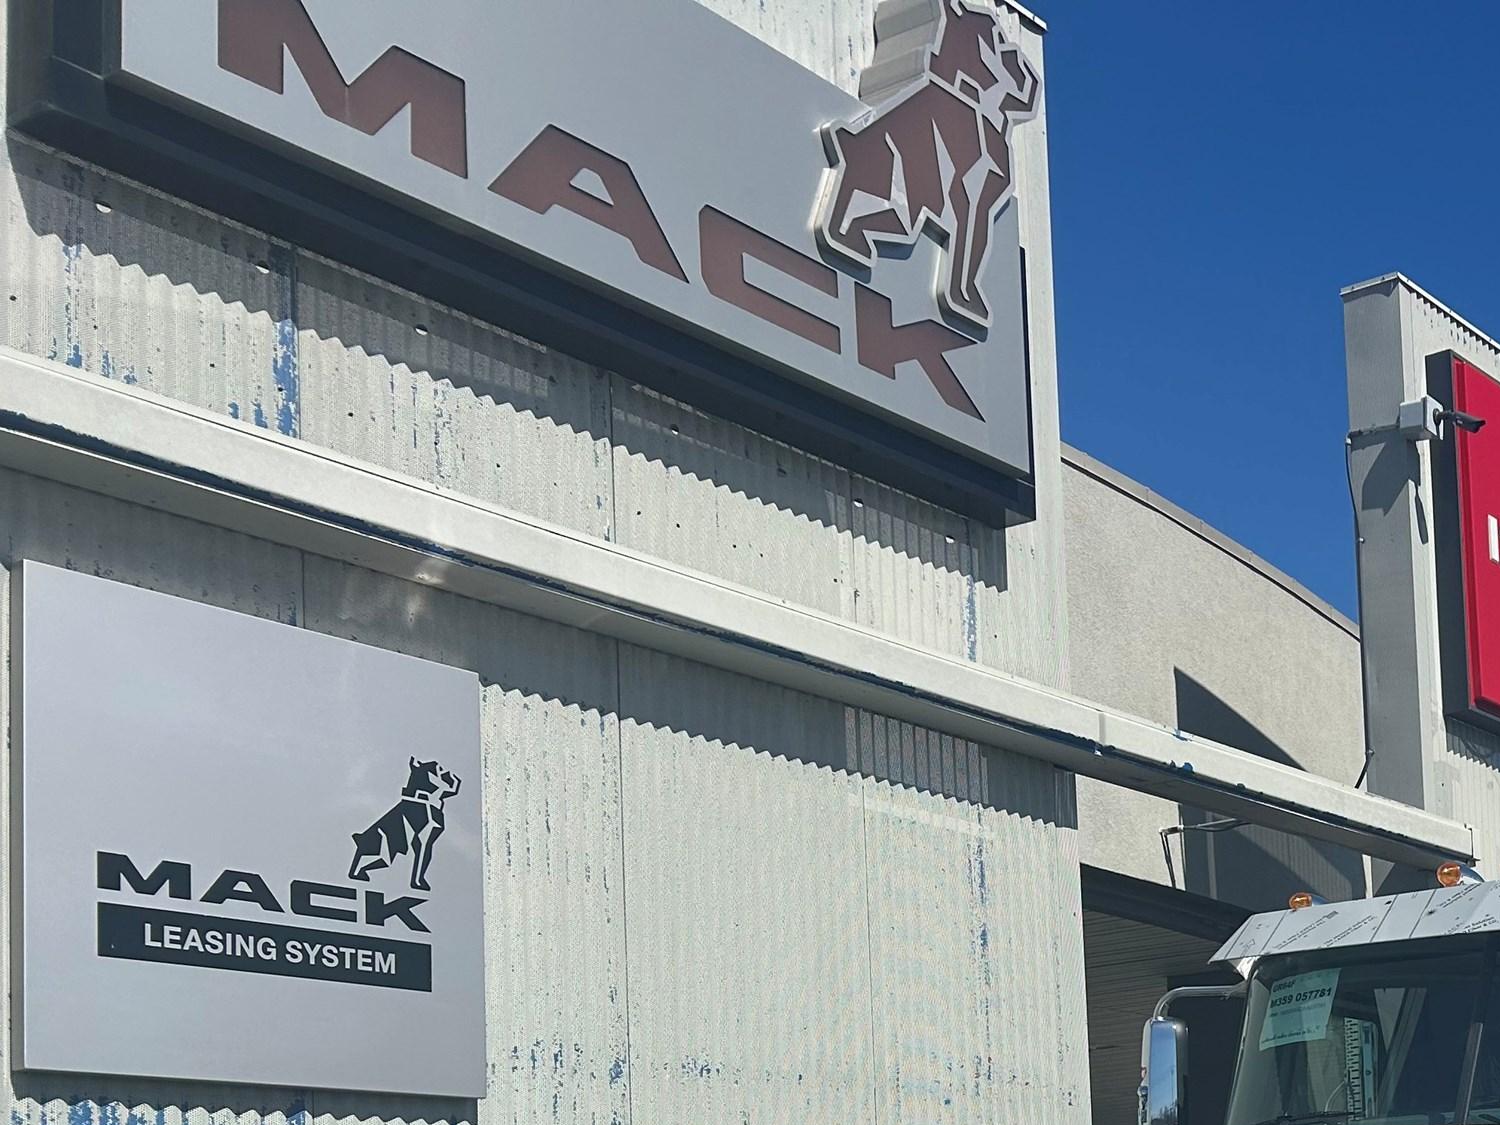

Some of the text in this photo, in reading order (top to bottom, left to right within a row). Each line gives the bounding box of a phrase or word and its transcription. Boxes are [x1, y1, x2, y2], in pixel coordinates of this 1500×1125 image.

[217, 0, 985, 421] MACK
[96, 850, 431, 932] MACK
[143, 923, 397, 975] LEASING SYSTEM
